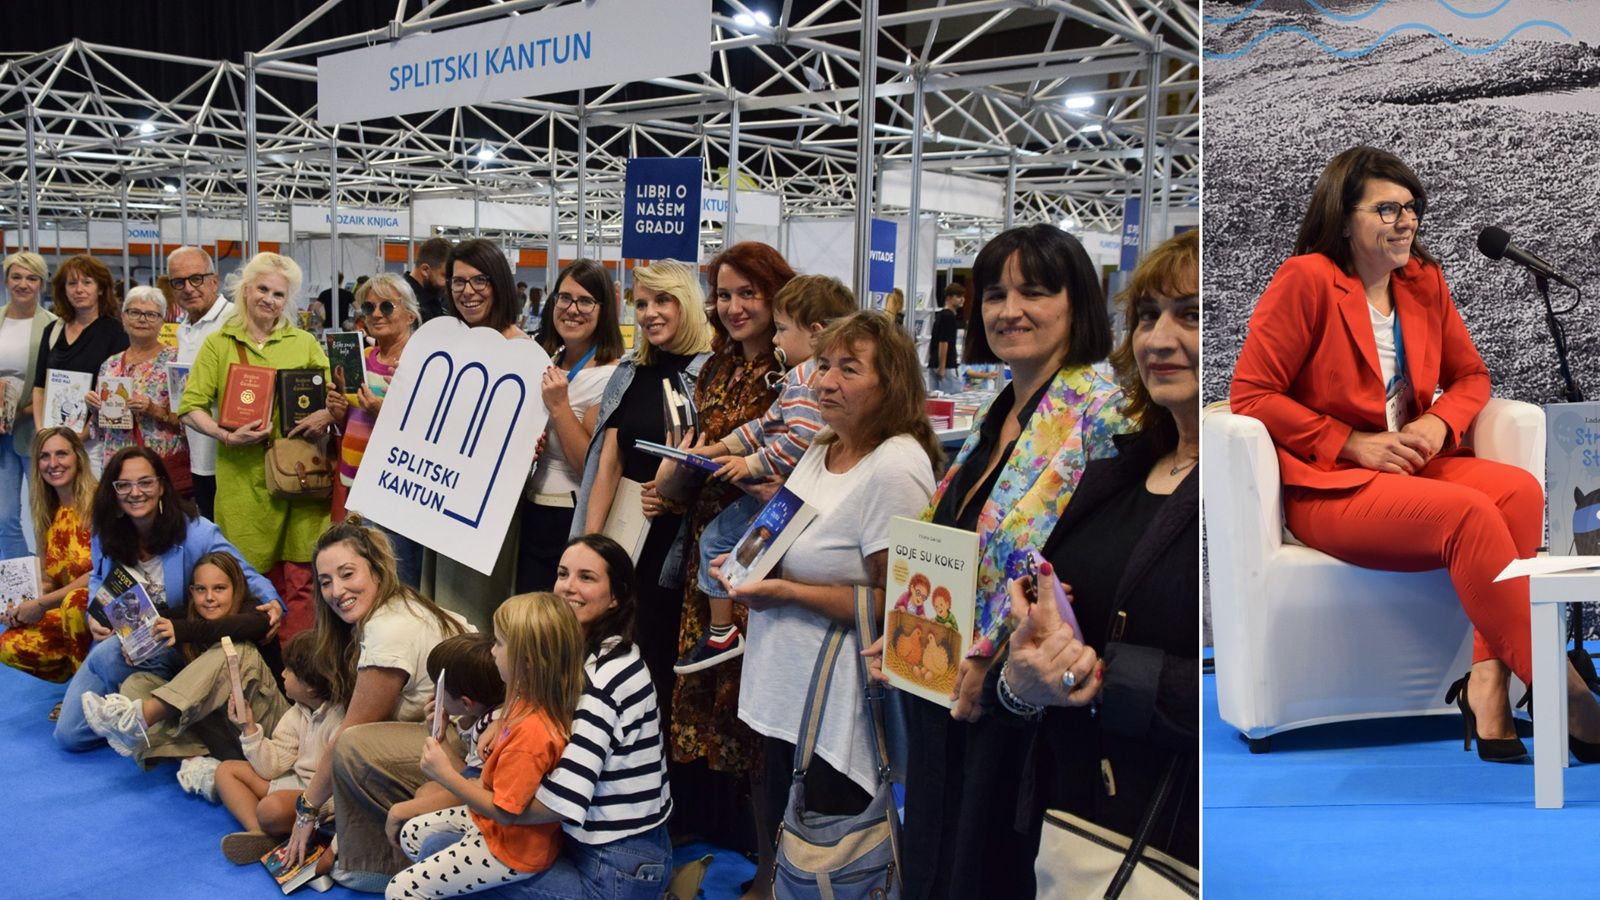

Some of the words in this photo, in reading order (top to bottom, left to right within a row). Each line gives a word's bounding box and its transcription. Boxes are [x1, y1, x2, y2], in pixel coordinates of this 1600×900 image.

[389, 51, 478, 92] SPLITSKI
[485, 31, 592, 76] KANTUN
[636, 184, 671, 199] LIBRI
[675, 184, 688, 199] O
[636, 197, 685, 217] NAŠEM
[367, 216, 399, 229] KNJIGA
[635, 219, 685, 235] GRADU
[387, 446, 460, 489] SPLITSKI
[378, 470, 445, 512] KANTUN
[895, 544, 917, 561] GDJE
[920, 550, 933, 563] SU
[934, 554, 966, 572] KOKE?
